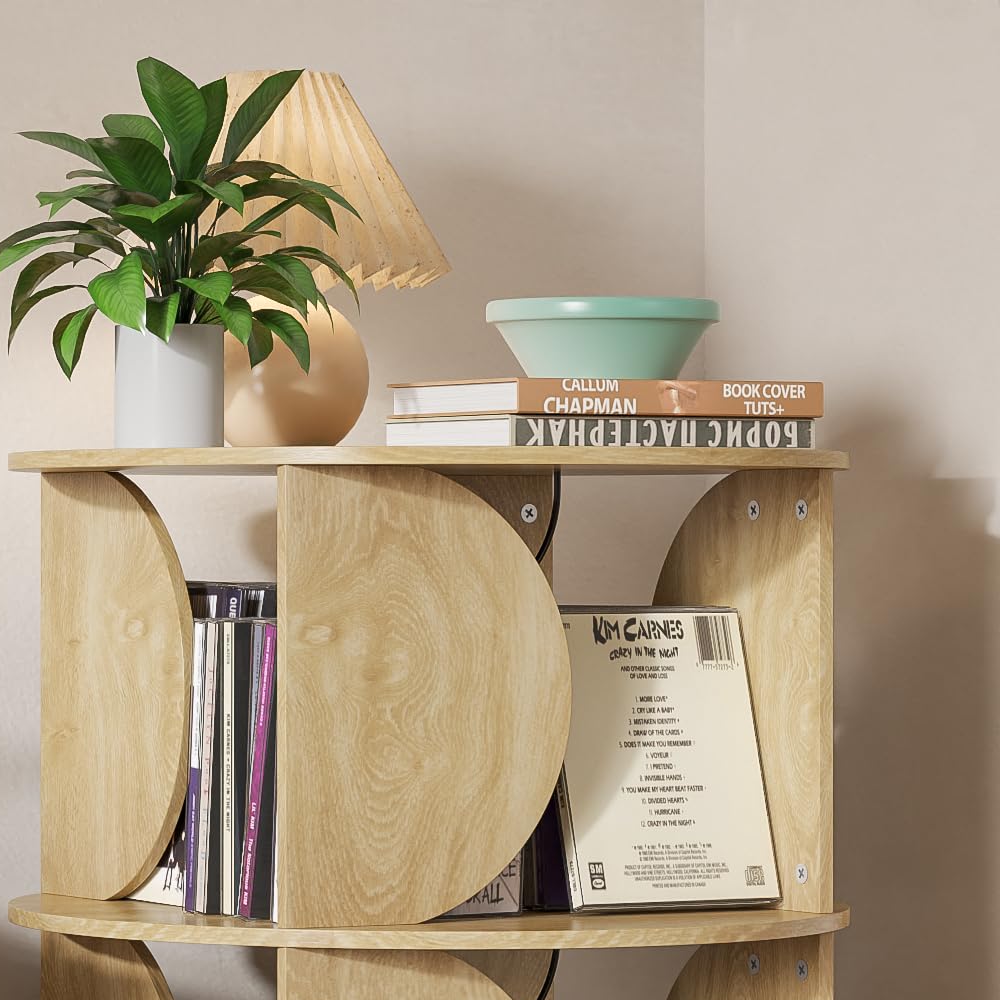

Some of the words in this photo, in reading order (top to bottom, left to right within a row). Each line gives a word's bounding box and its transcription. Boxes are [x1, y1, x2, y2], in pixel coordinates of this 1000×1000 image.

[562, 379, 619, 392] CALLUM
[723, 384, 761, 399] BOOK
[764, 385, 805, 399] COVER
[544, 397, 636, 414] CHAPMAN
[744, 401, 784, 415] TUTS+
[526, 419, 698, 446] ПАСТЕРНАК
[709, 421, 797, 447] БОРИС
[593, 616, 620, 644] KIM
[624, 618, 684, 641] CARNES
[610, 647, 632, 660] CRAZY
[635, 647, 642, 656] IN
[644, 646, 655, 658] THE
[659, 647, 678, 658] NIGHT
